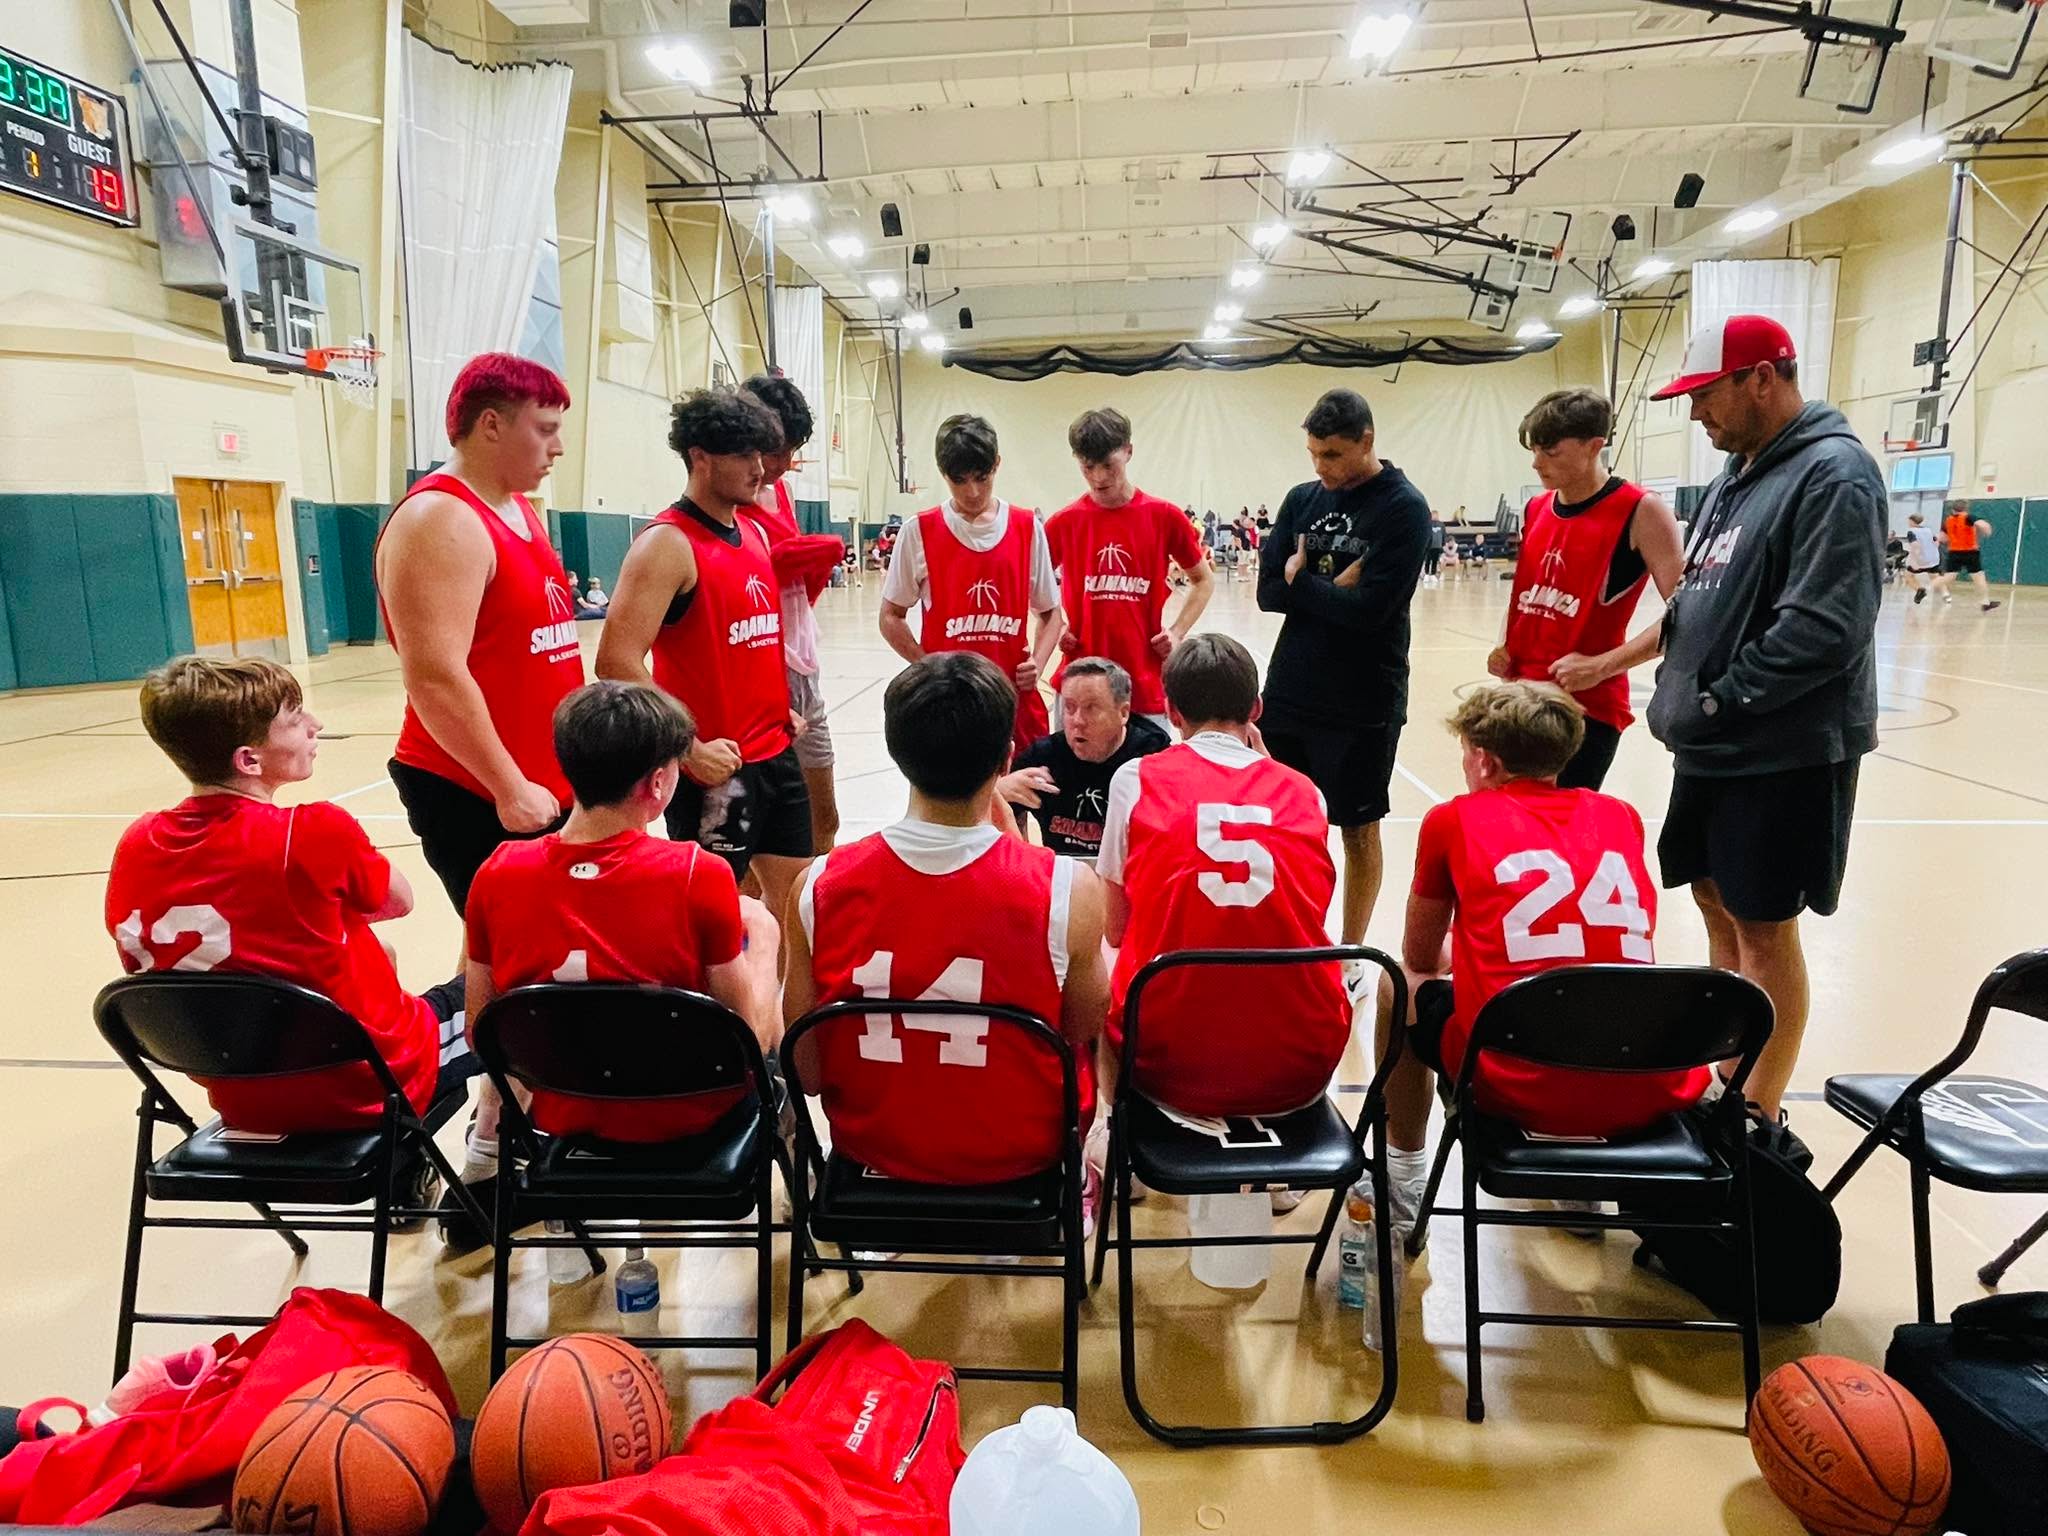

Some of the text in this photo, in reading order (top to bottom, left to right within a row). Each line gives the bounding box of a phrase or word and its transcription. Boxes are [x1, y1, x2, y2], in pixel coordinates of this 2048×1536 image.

[6, 120, 45, 146] PERIOD
[67, 133, 112, 165] GUEST
[90, 166, 120, 211] 13
[1197, 802, 1275, 908] 5
[1493, 849, 1653, 963] 24
[851, 949, 990, 1068] 14
[1342, 1252, 1358, 1266] G
